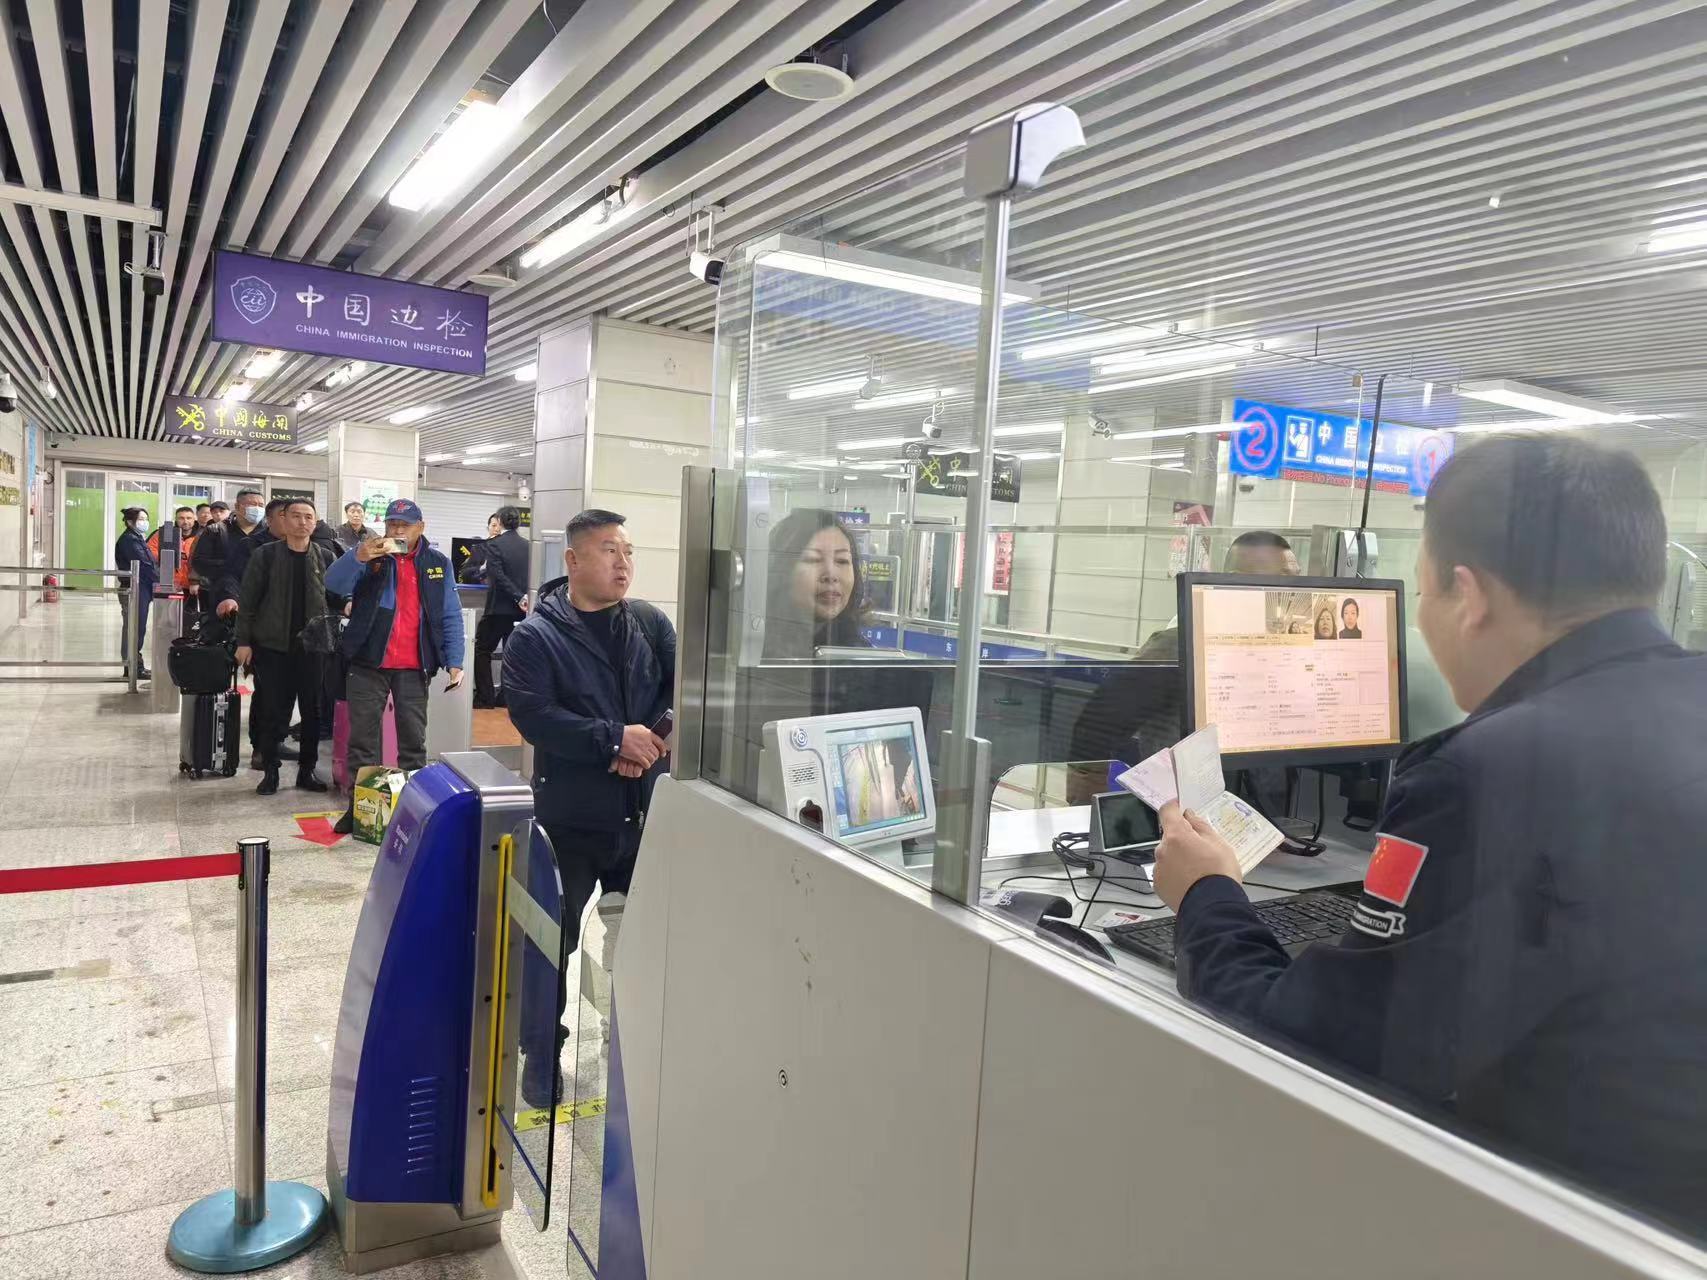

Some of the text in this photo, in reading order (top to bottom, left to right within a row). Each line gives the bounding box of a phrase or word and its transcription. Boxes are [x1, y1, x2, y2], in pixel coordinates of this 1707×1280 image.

[296, 284, 473, 340] 中国边检
[296, 324, 473, 358] CHINA IMMIGRATION INSPECTION
[212, 428, 292, 441] CHINA CUSTOMS
[1247, 421, 1266, 456] 2
